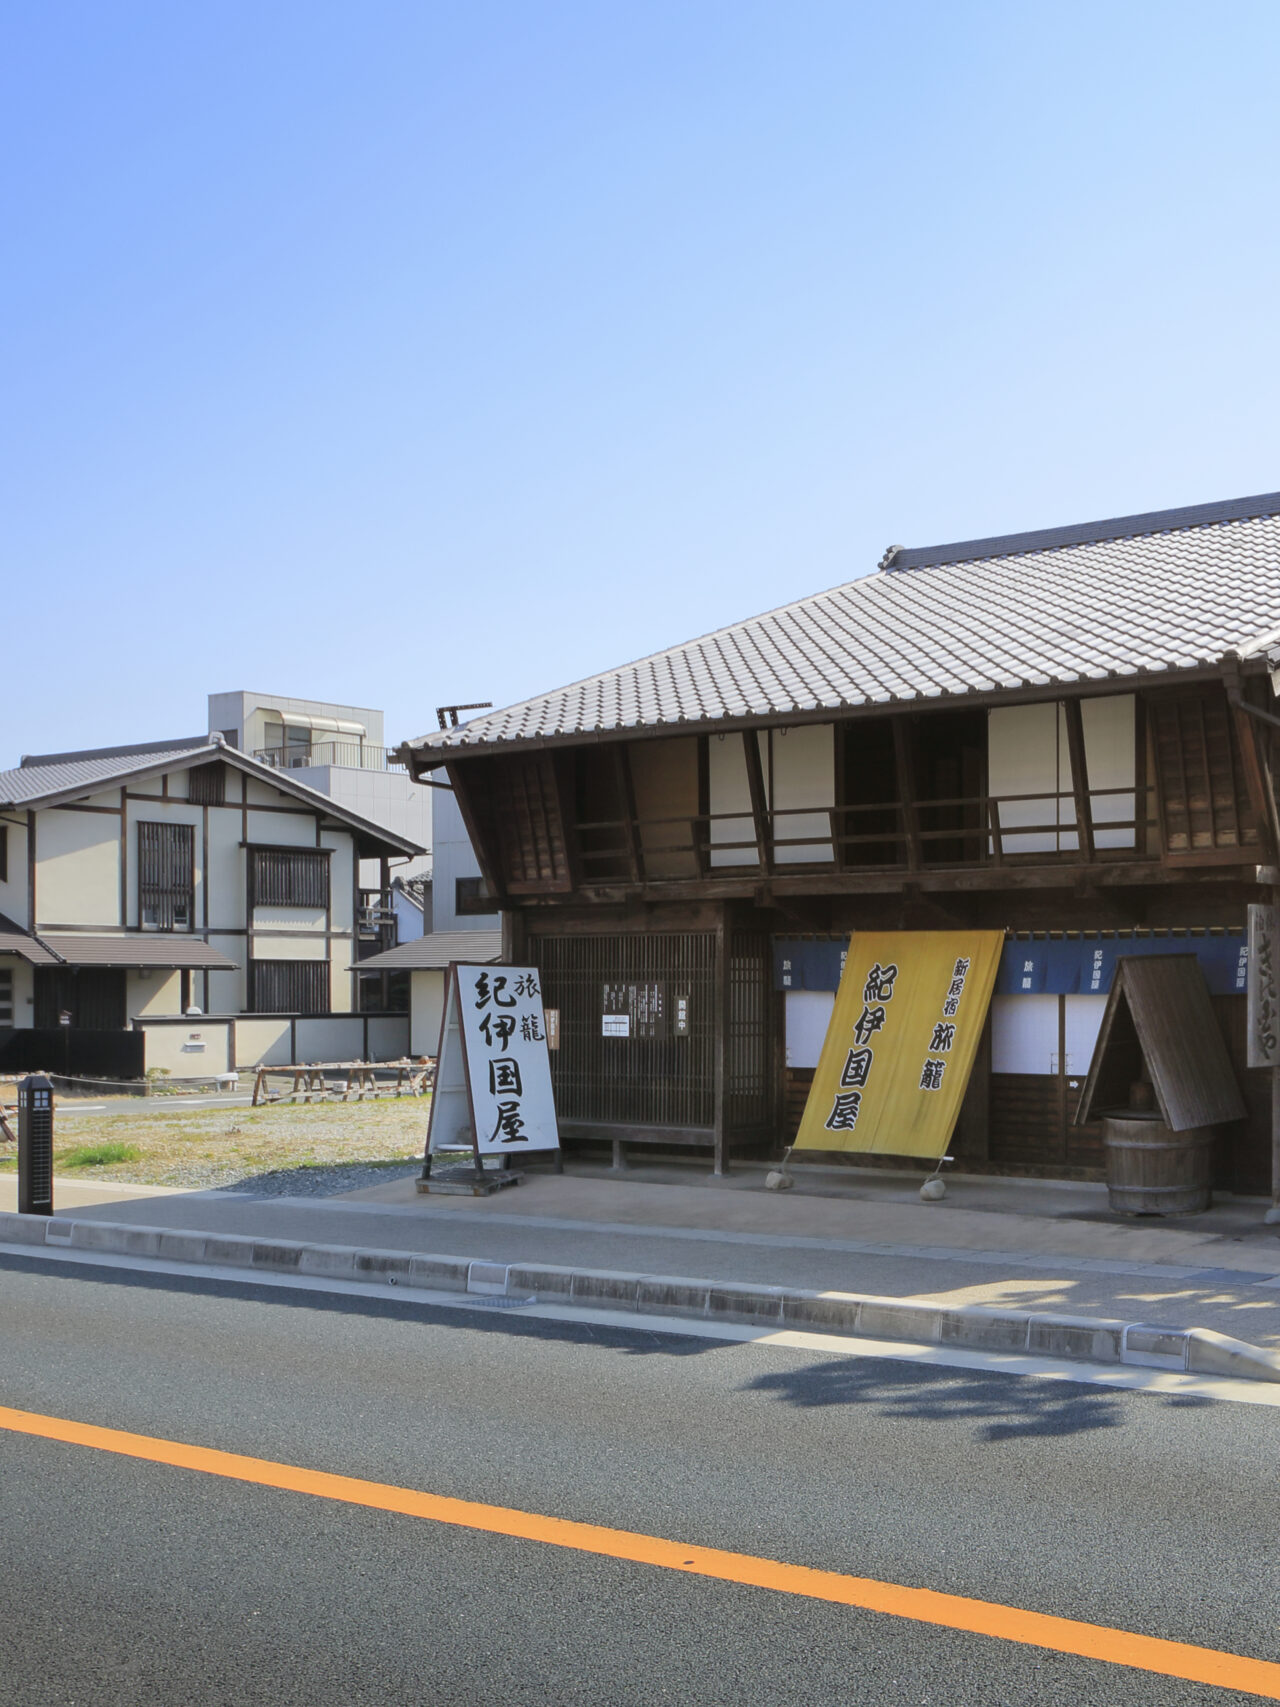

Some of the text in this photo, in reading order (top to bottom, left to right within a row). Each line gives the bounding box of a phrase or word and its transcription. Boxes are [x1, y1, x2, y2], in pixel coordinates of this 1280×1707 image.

[513, 973, 545, 1042] 旅籠
[1091, 950, 1103, 990] 紀伊国屋
[474, 972, 529, 1143] 紀伊国屋
[824, 962, 898, 1132] 紀伊国屋
